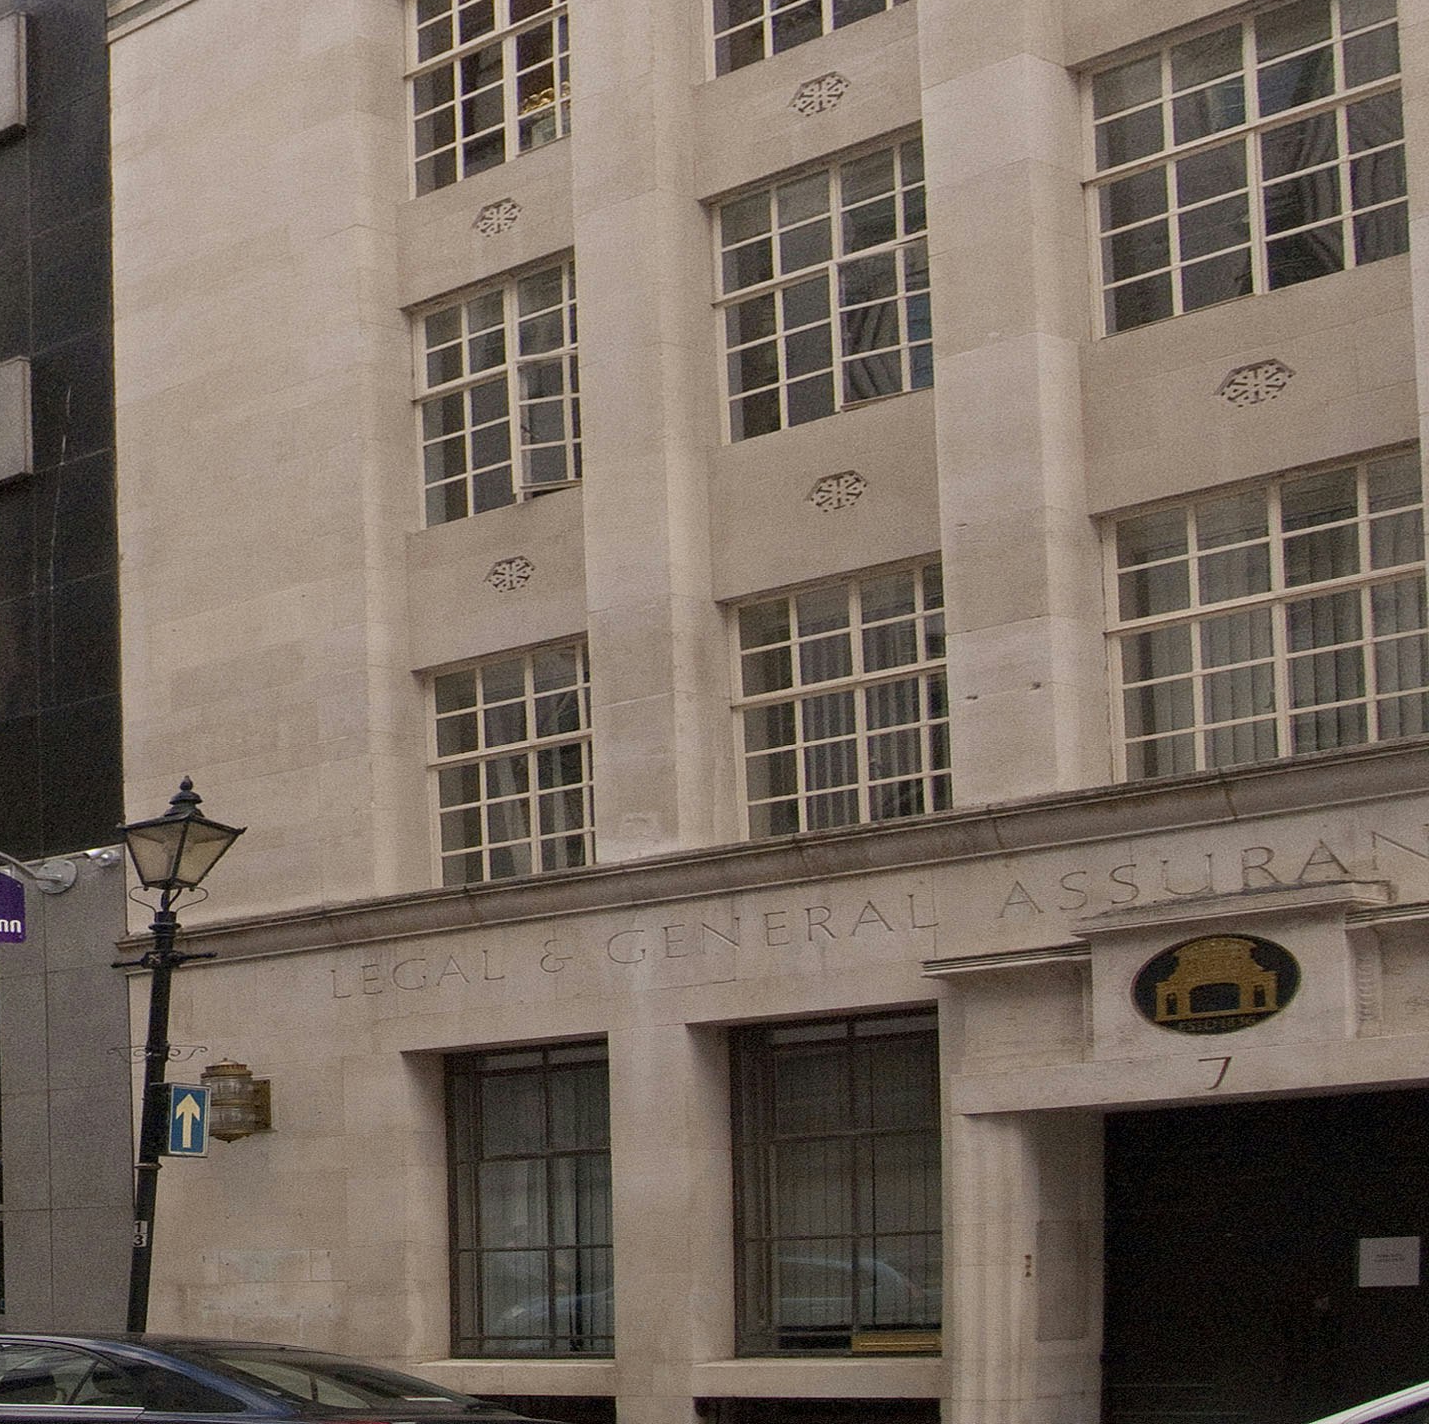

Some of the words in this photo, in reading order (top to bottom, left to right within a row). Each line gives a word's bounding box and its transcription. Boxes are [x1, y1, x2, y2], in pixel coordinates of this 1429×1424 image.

[330, 949, 506, 1000] LEGAL
[540, 938, 573, 973] &
[606, 893, 940, 965] GENERAL
[997, 823, 1429, 918] ASSURAN
[1198, 1055, 1234, 1091] 7
